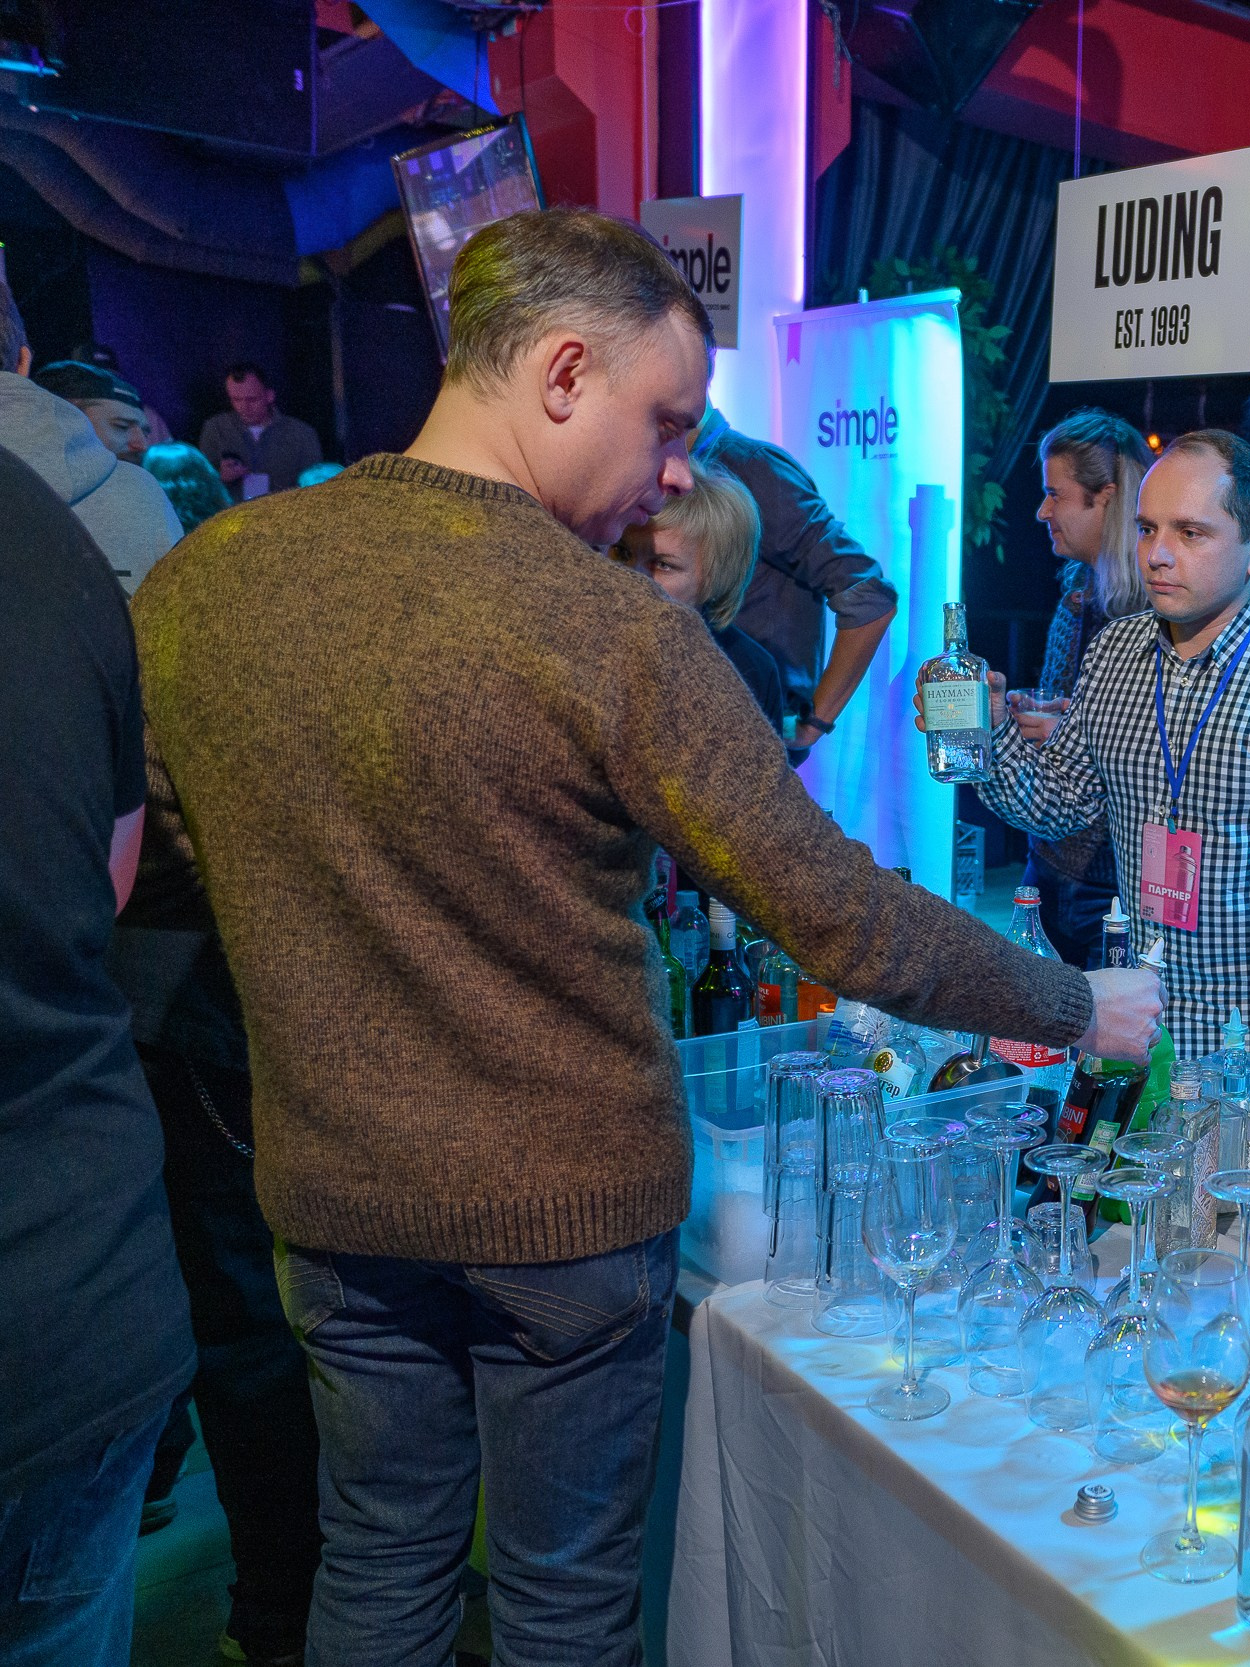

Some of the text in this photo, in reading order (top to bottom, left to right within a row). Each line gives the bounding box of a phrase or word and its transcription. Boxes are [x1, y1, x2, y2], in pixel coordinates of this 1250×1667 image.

[1094, 185, 1223, 289] LUDING
[1114, 303, 1191, 350] EST. 1993
[817, 396, 899, 460] simple
[1148, 883, 1192, 902] ПАРТНЕР
[1062, 1106, 1084, 1125] BINI
